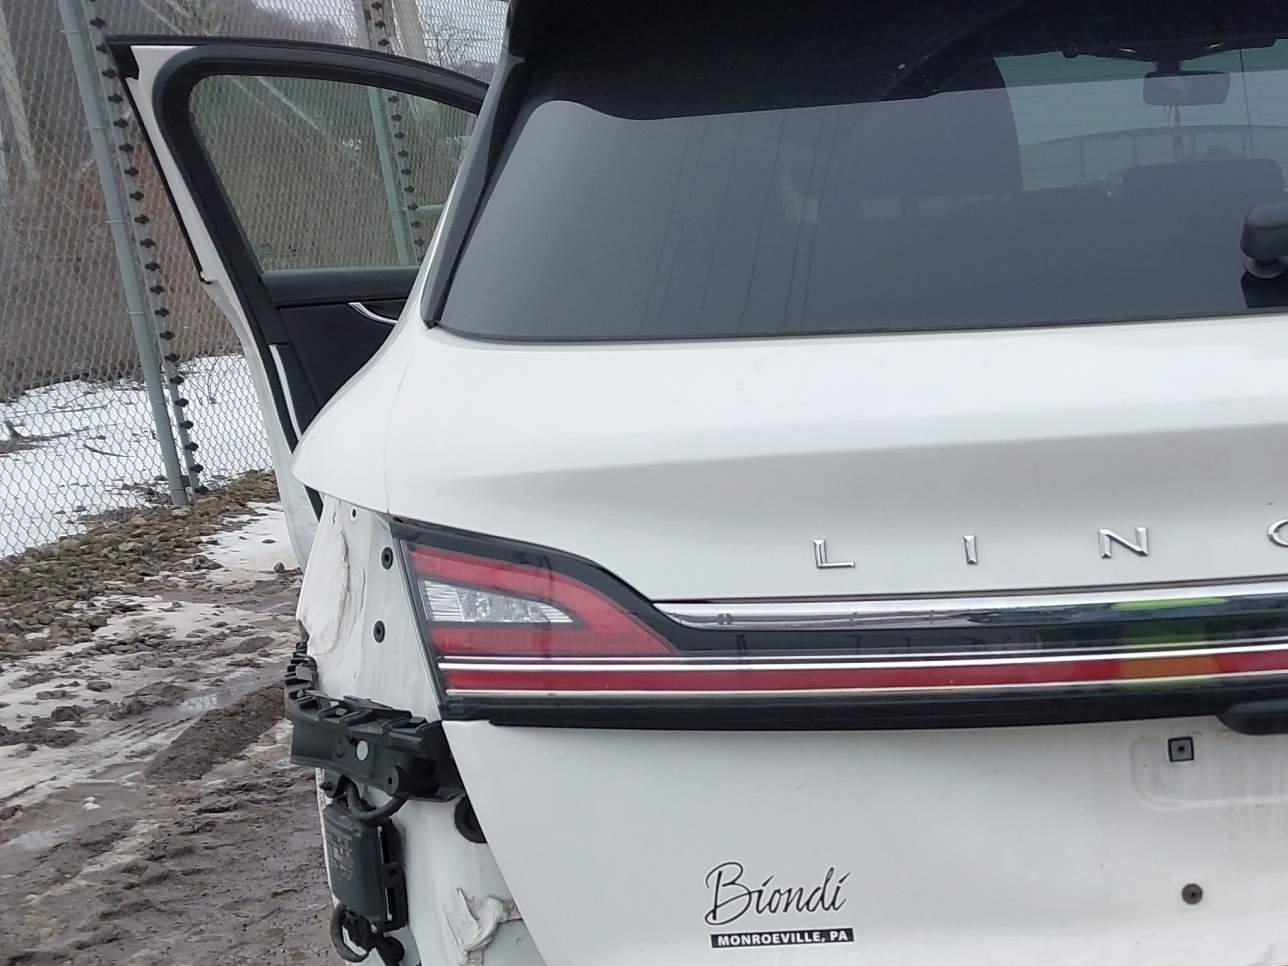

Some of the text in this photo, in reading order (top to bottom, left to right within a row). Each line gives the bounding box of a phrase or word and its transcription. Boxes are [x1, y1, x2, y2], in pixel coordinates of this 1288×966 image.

[704, 861, 851, 926] Biondi
[717, 930, 849, 946] MONROEVILLE, PA
